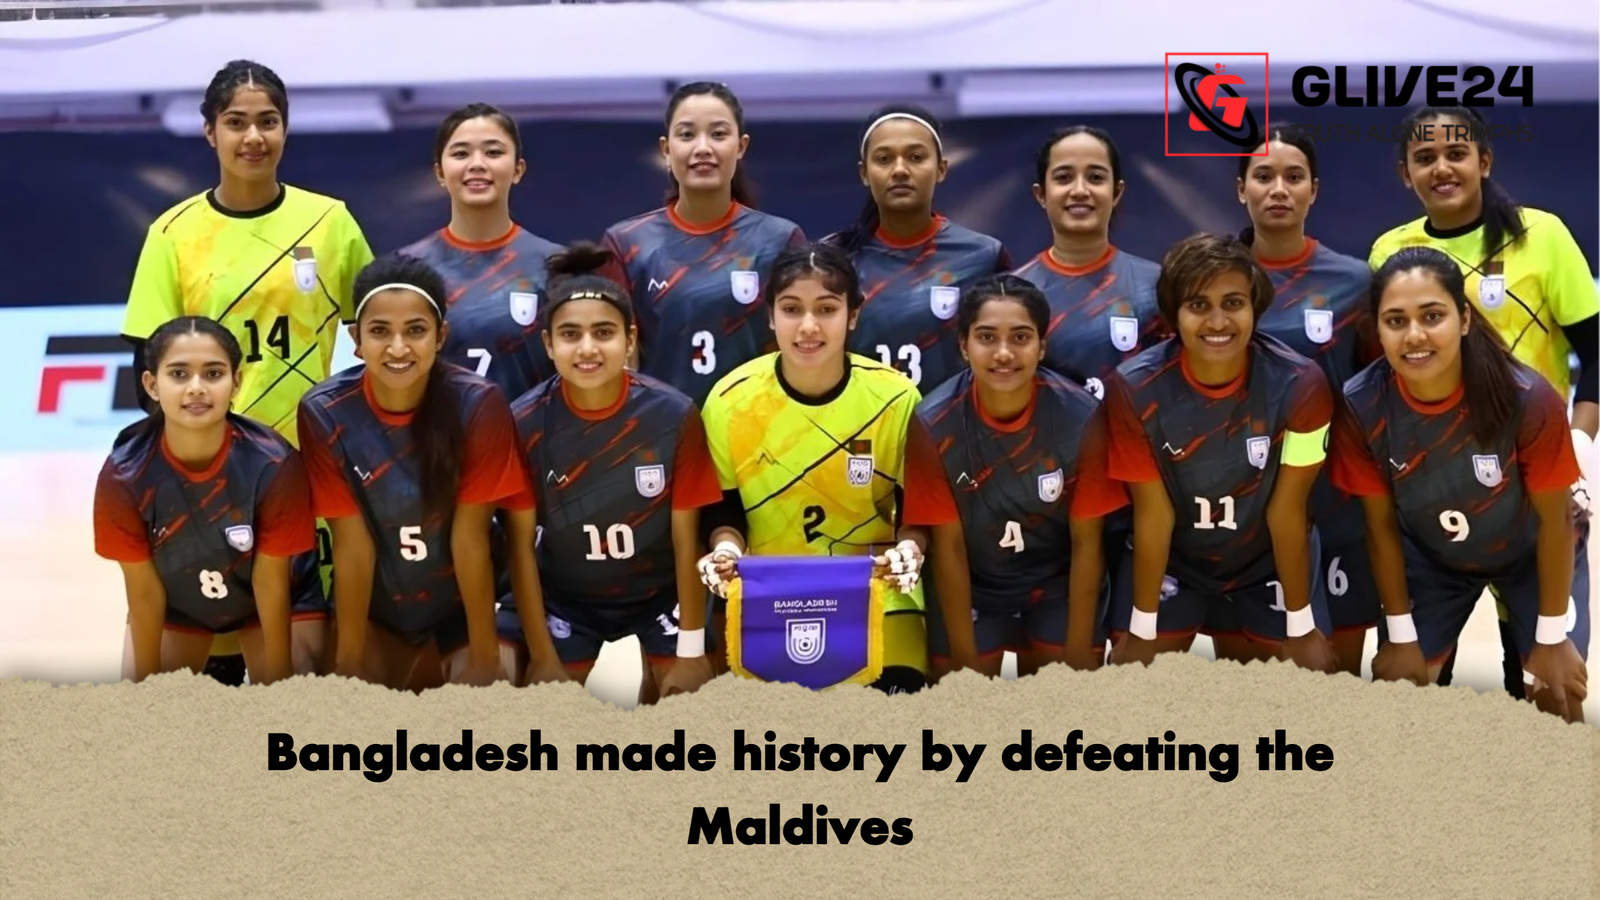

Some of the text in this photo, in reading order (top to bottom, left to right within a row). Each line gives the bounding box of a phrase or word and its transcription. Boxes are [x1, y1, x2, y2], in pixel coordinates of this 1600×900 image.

[244, 315, 290, 363] 14
[692, 330, 716, 375] 3
[467, 348, 492, 377] 7
[876, 344, 922, 387] 13
[803, 505, 826, 544] 2
[1193, 495, 1238, 530] 11
[1439, 510, 1470, 542] 9
[399, 525, 427, 562] 5
[584, 523, 635, 561] 10
[999, 520, 1025, 553] 4
[199, 569, 228, 600] 8
[1327, 556, 1349, 597] 6
